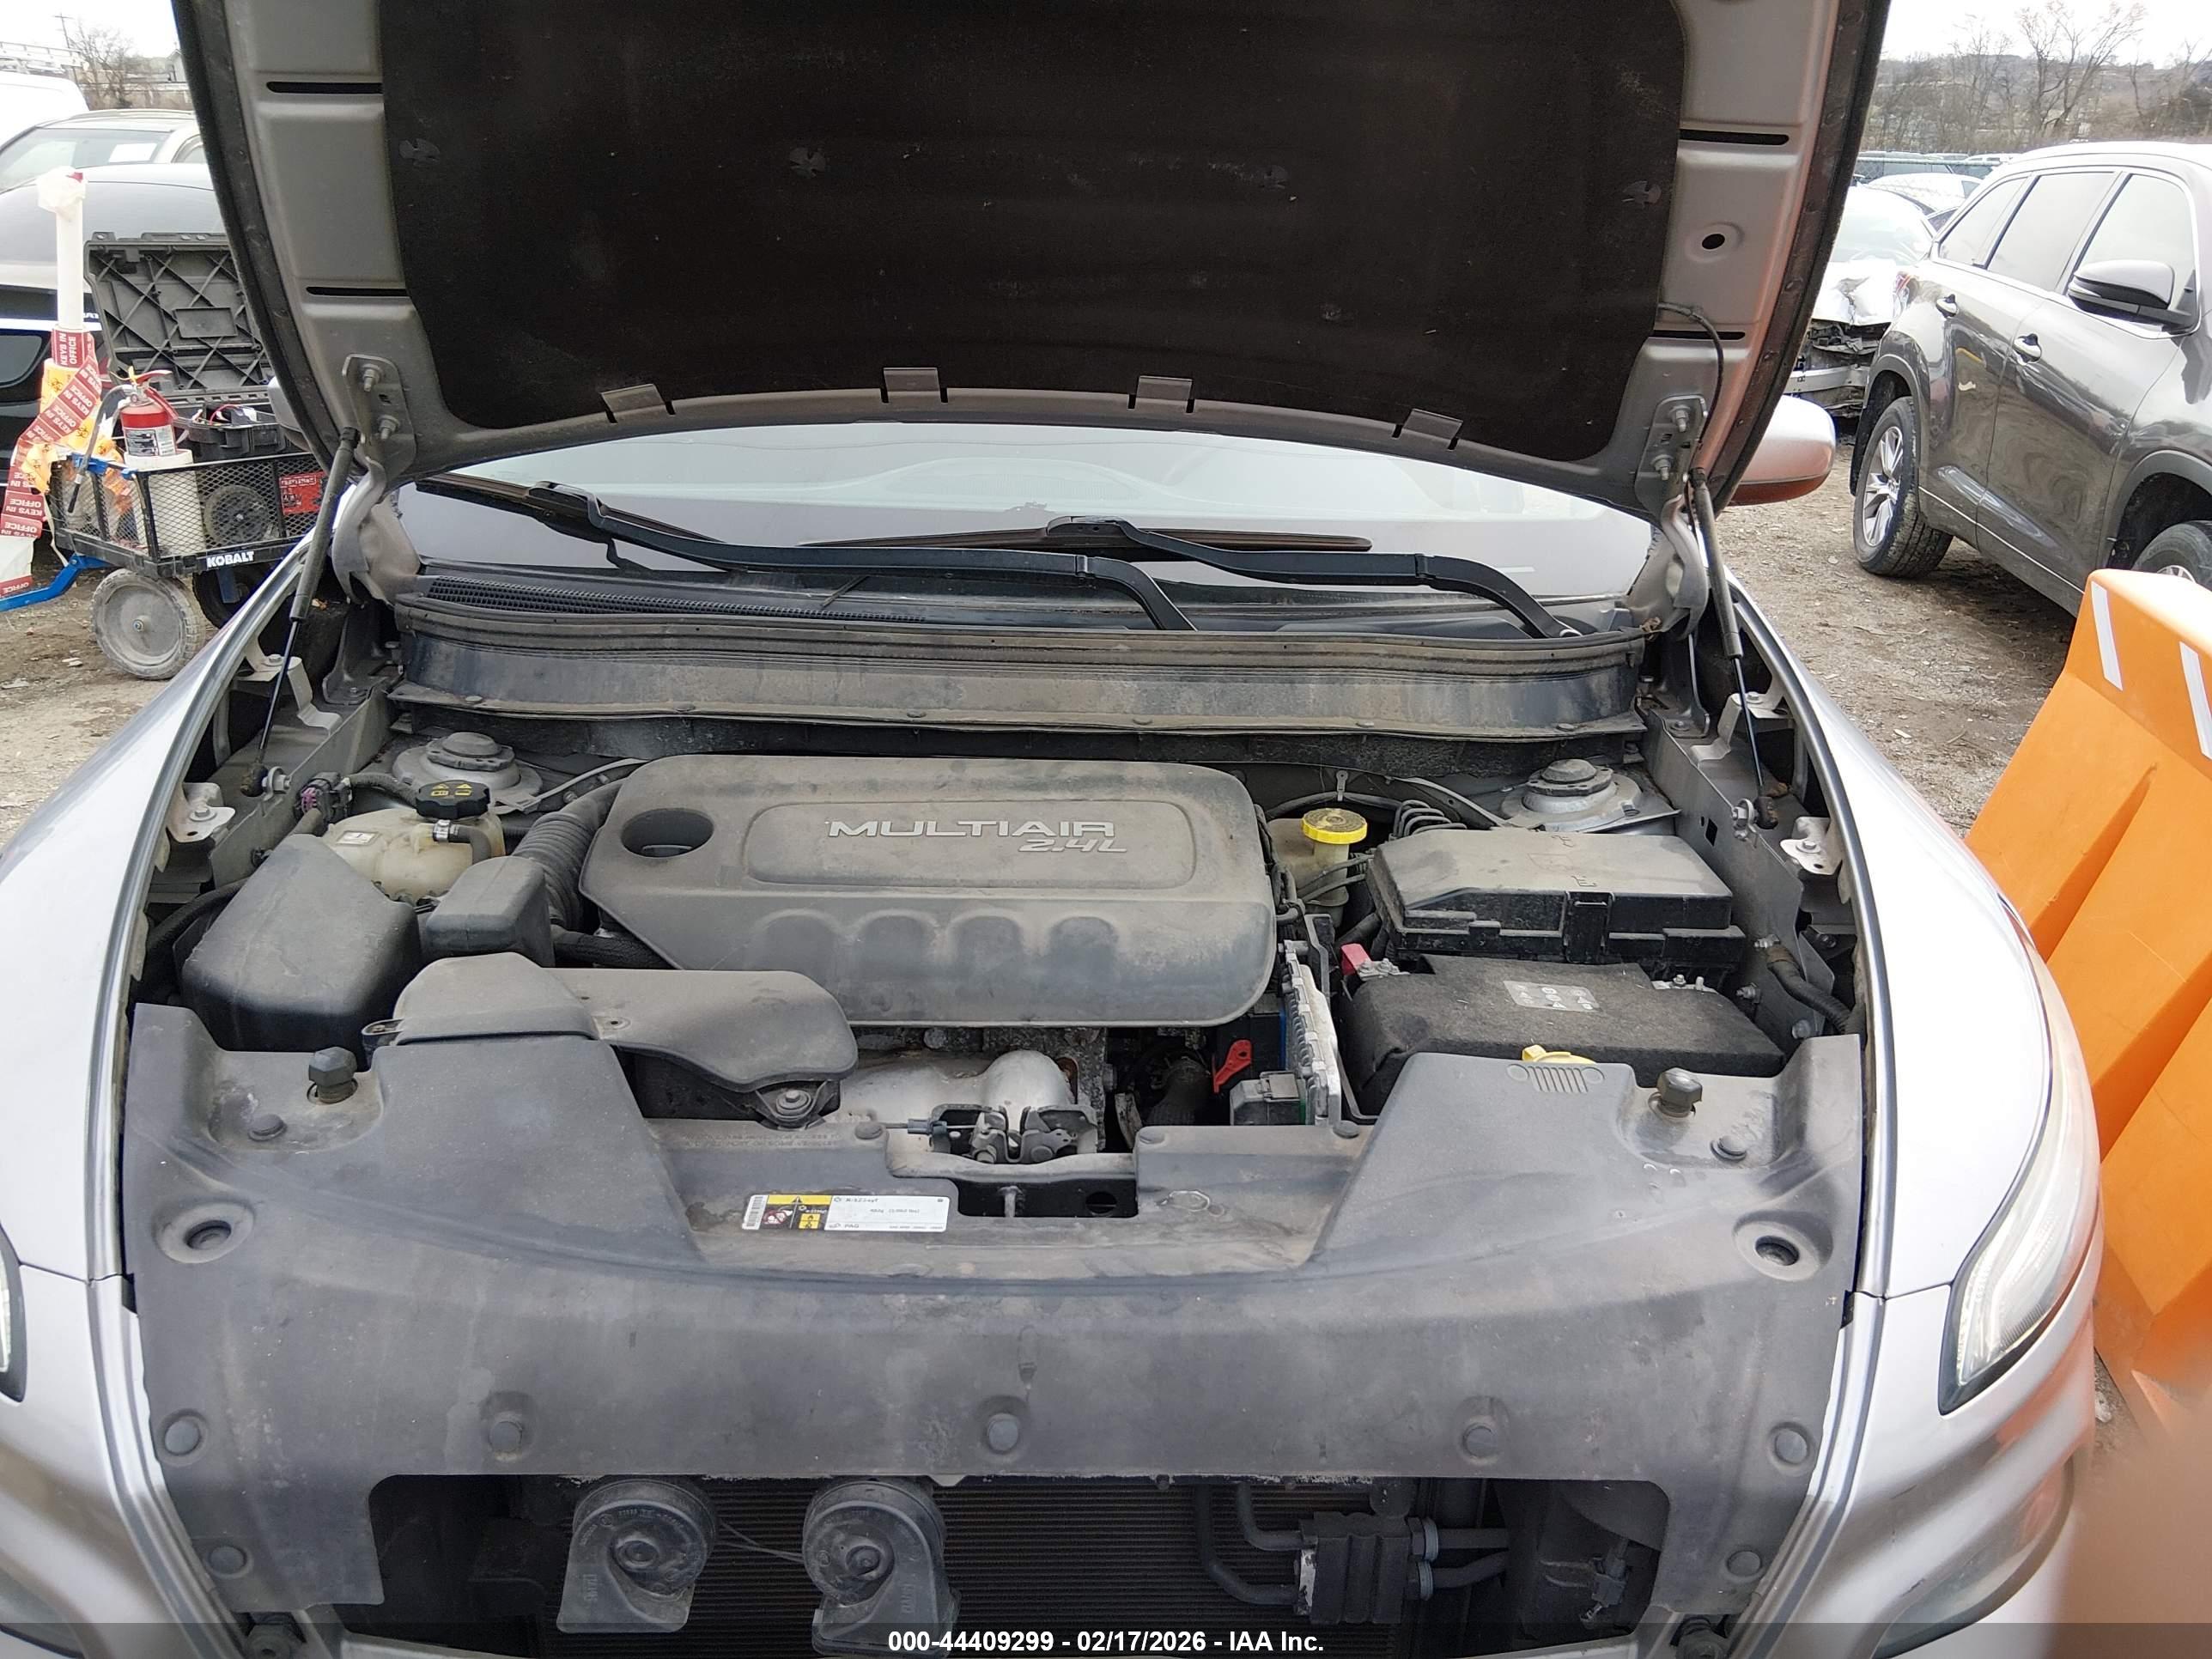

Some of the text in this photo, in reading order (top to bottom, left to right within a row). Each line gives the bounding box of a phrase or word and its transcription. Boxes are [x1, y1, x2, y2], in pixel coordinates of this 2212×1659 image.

[58, 332, 68, 366] KEYS IN
[68, 336, 77, 365] OFFICE
[70, 384, 93, 407] OFFICE
[52, 404, 76, 428] OFFICE
[9, 498, 41, 508] OFFICE
[18, 507, 43, 516] KEYS
[4, 521, 37, 533] OFFICE
[207, 550, 255, 568] KOBALT
[828, 821, 1115, 837] MULTIAIR
[1018, 838, 1127, 853] 2.4L
